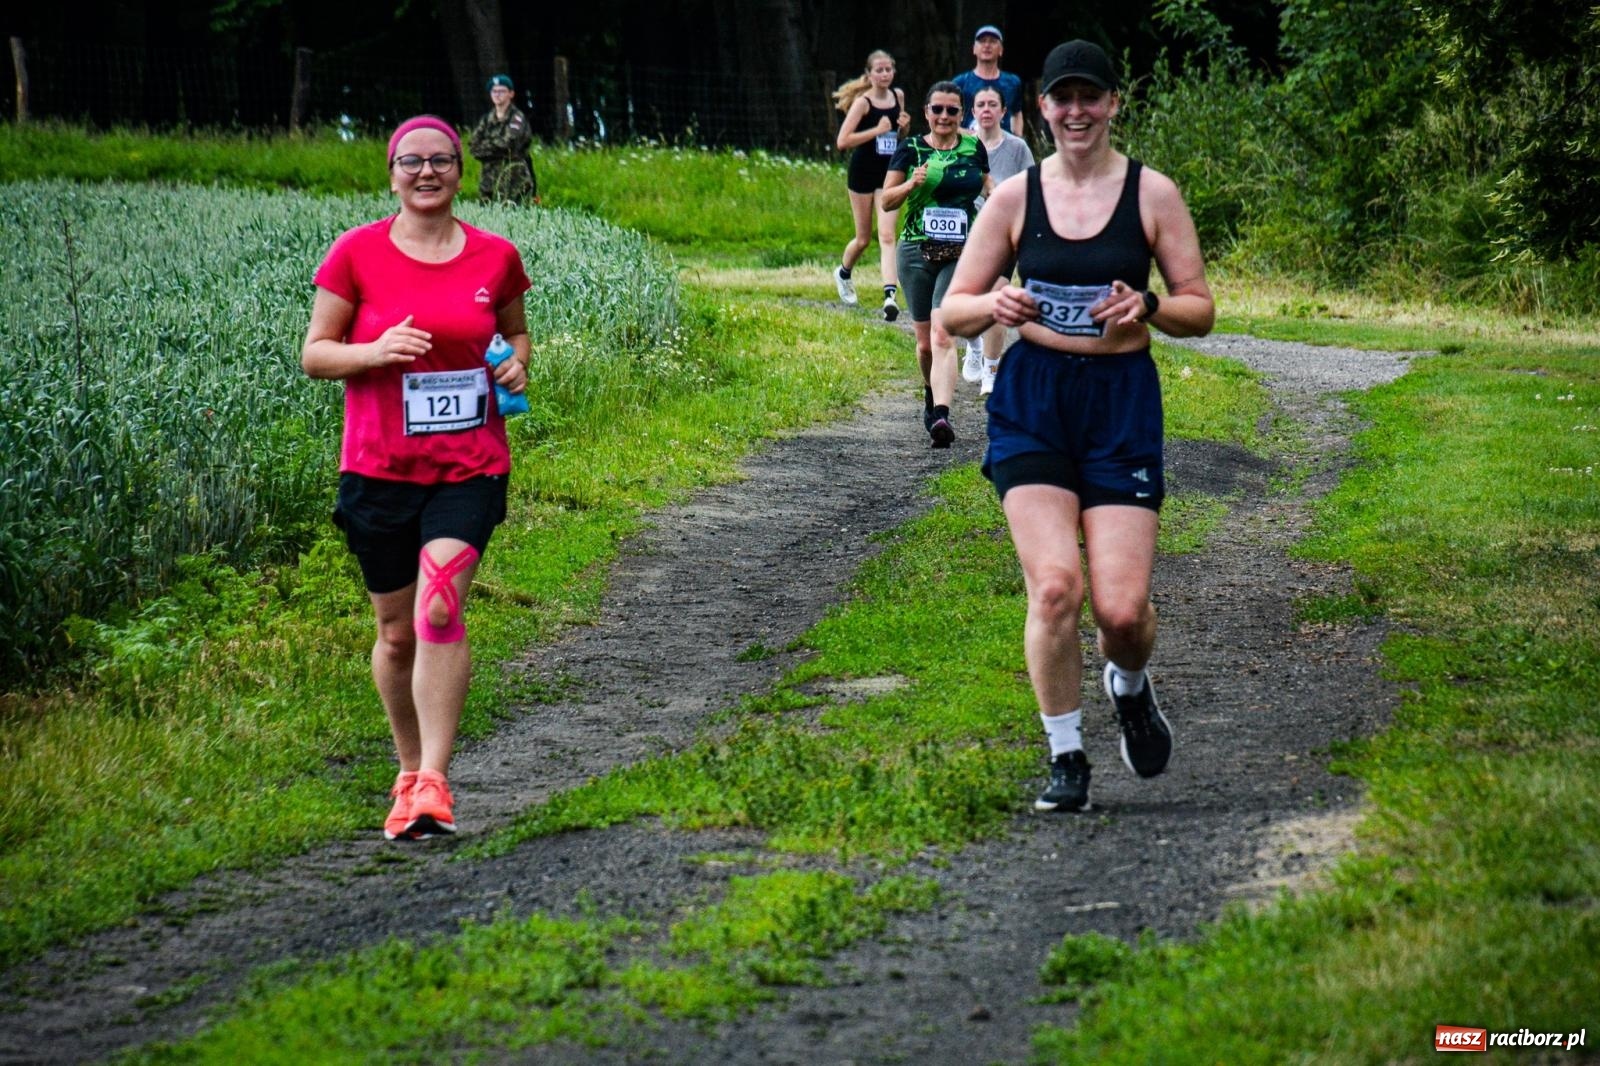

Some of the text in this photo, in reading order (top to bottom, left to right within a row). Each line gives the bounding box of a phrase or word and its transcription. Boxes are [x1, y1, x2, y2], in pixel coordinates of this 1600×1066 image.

[930, 219, 956, 231] 030
[1039, 301, 1087, 322] 037
[427, 395, 460, 416] 121
